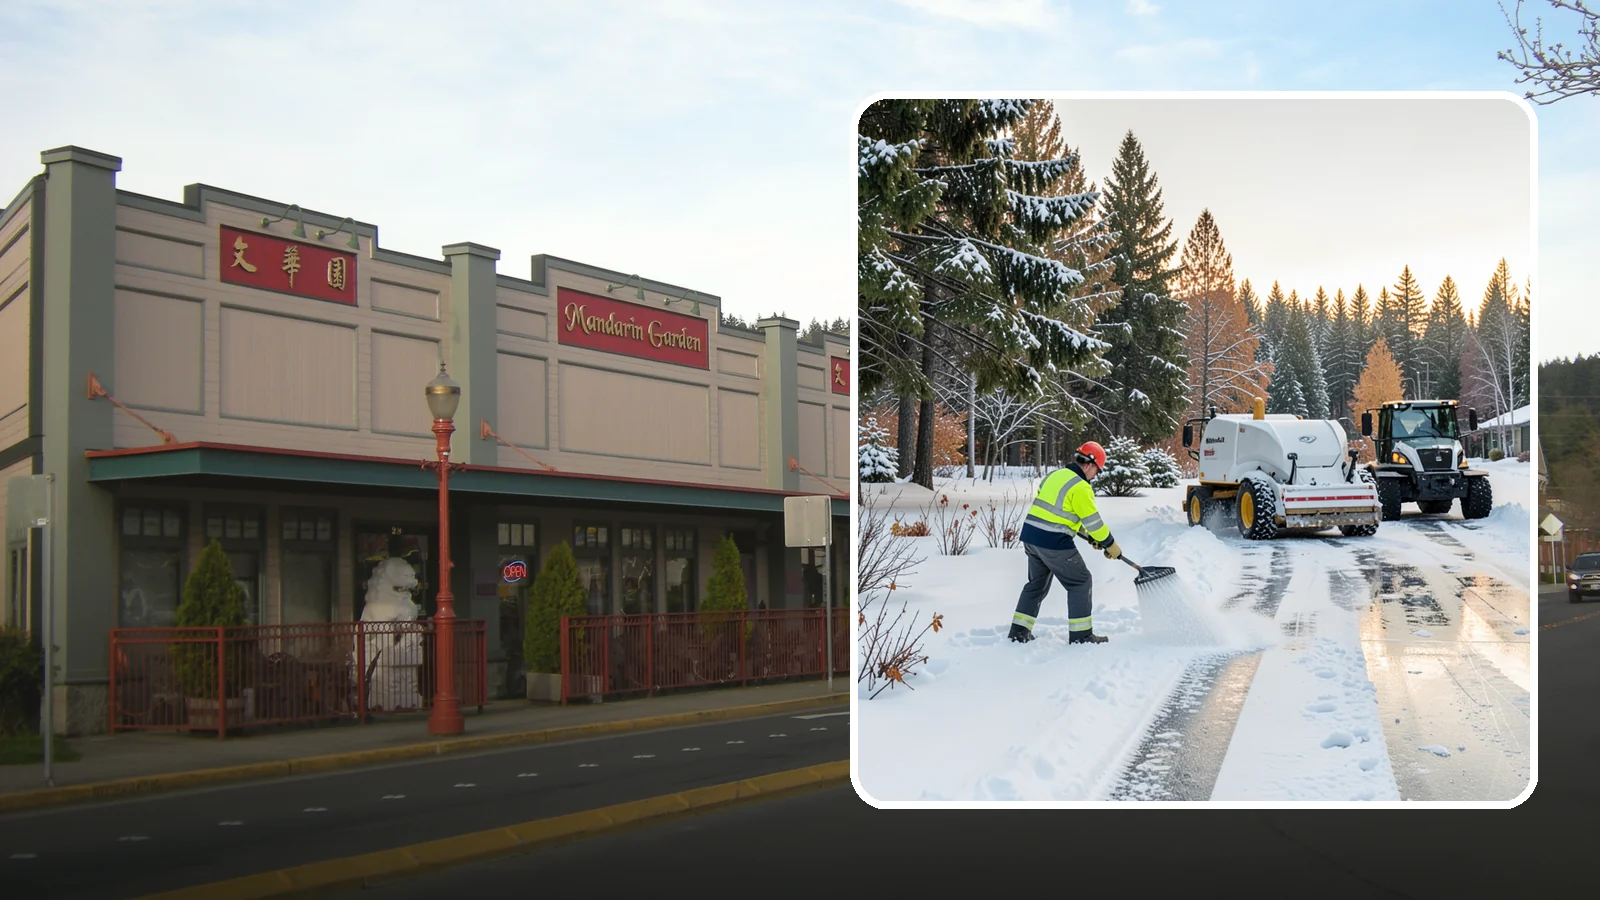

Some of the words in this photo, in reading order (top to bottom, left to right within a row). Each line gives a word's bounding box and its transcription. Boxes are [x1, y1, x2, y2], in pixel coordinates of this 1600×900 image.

[564, 302, 644, 341] Mandarin
[648, 320, 701, 353] Garden
[503, 565, 527, 578] OPEN
